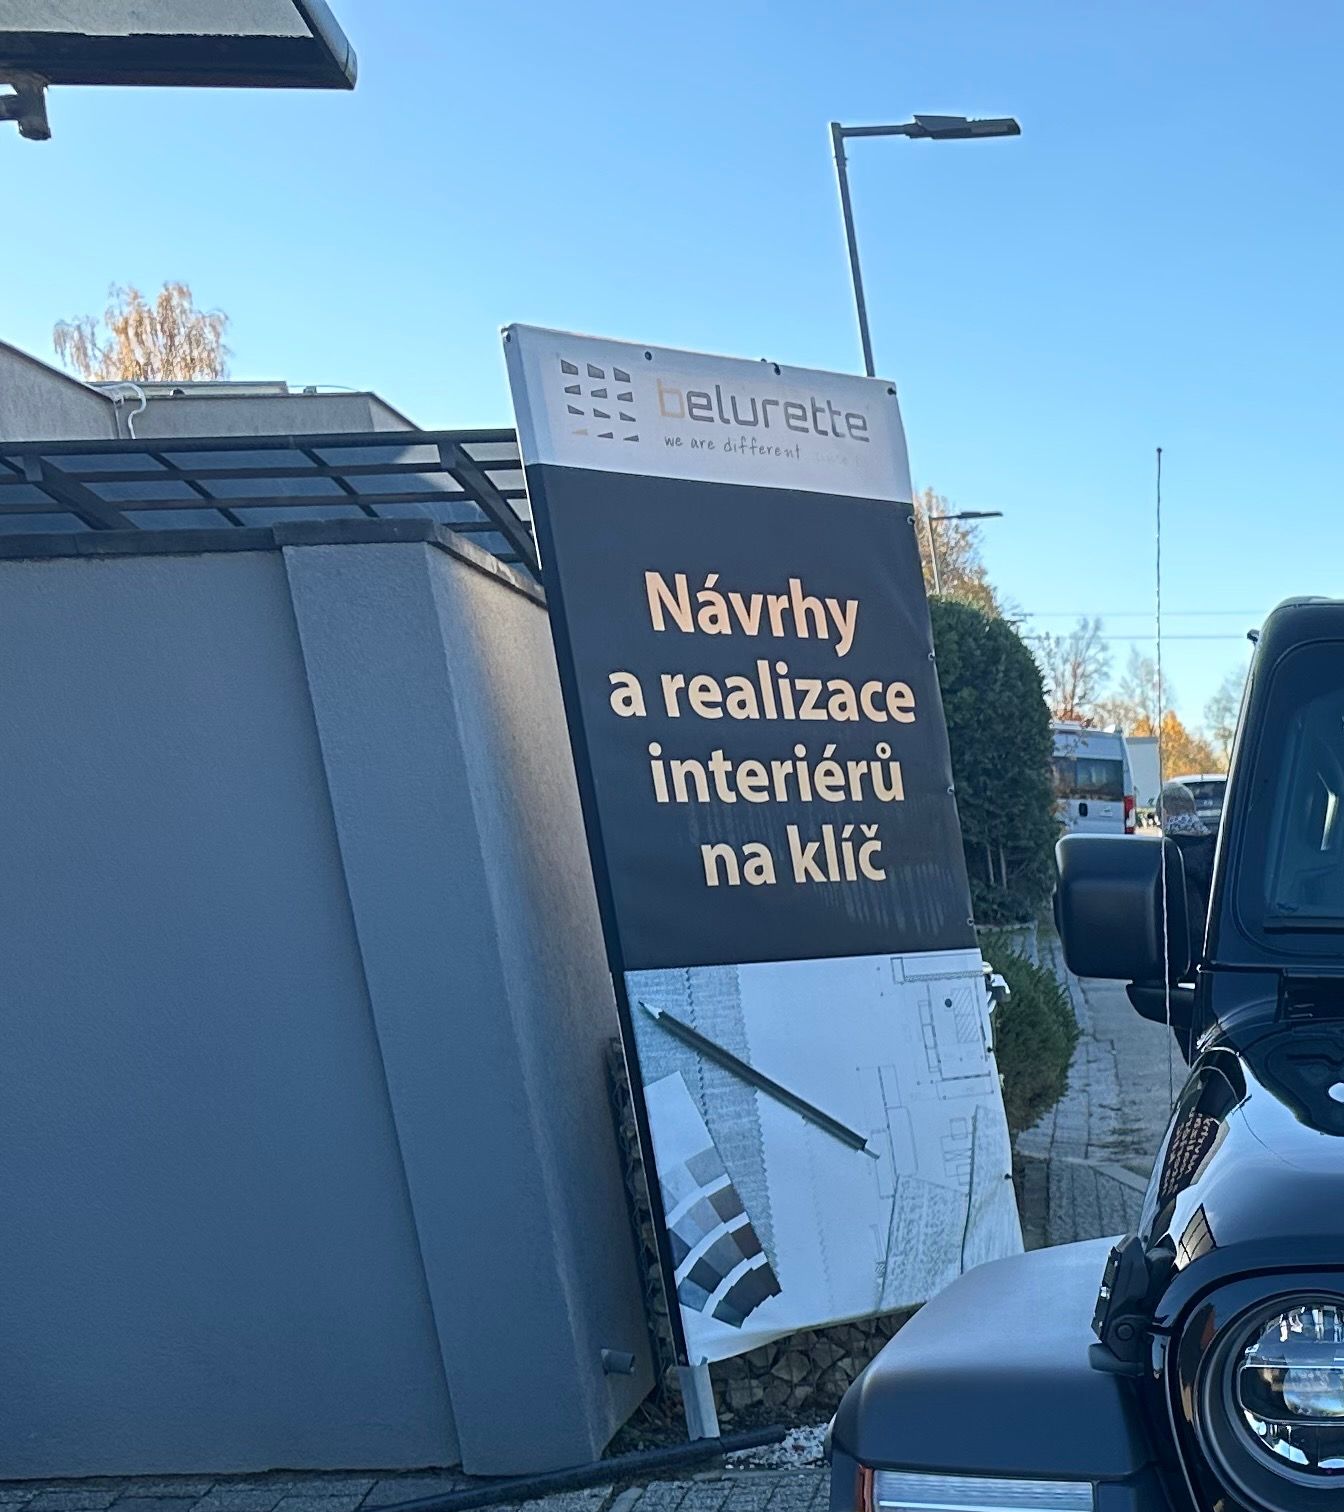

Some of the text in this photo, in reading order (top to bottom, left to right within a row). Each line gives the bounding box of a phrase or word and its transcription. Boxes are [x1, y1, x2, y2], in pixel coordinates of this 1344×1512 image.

[657, 377, 870, 443] belurette
[664, 434, 684, 448] we
[690, 438, 716, 451] are
[723, 435, 801, 460] different
[644, 570, 858, 658] Návrhy
[608, 660, 917, 724] a realizace
[648, 742, 905, 804] interiérů
[700, 823, 887, 888] na klíč
